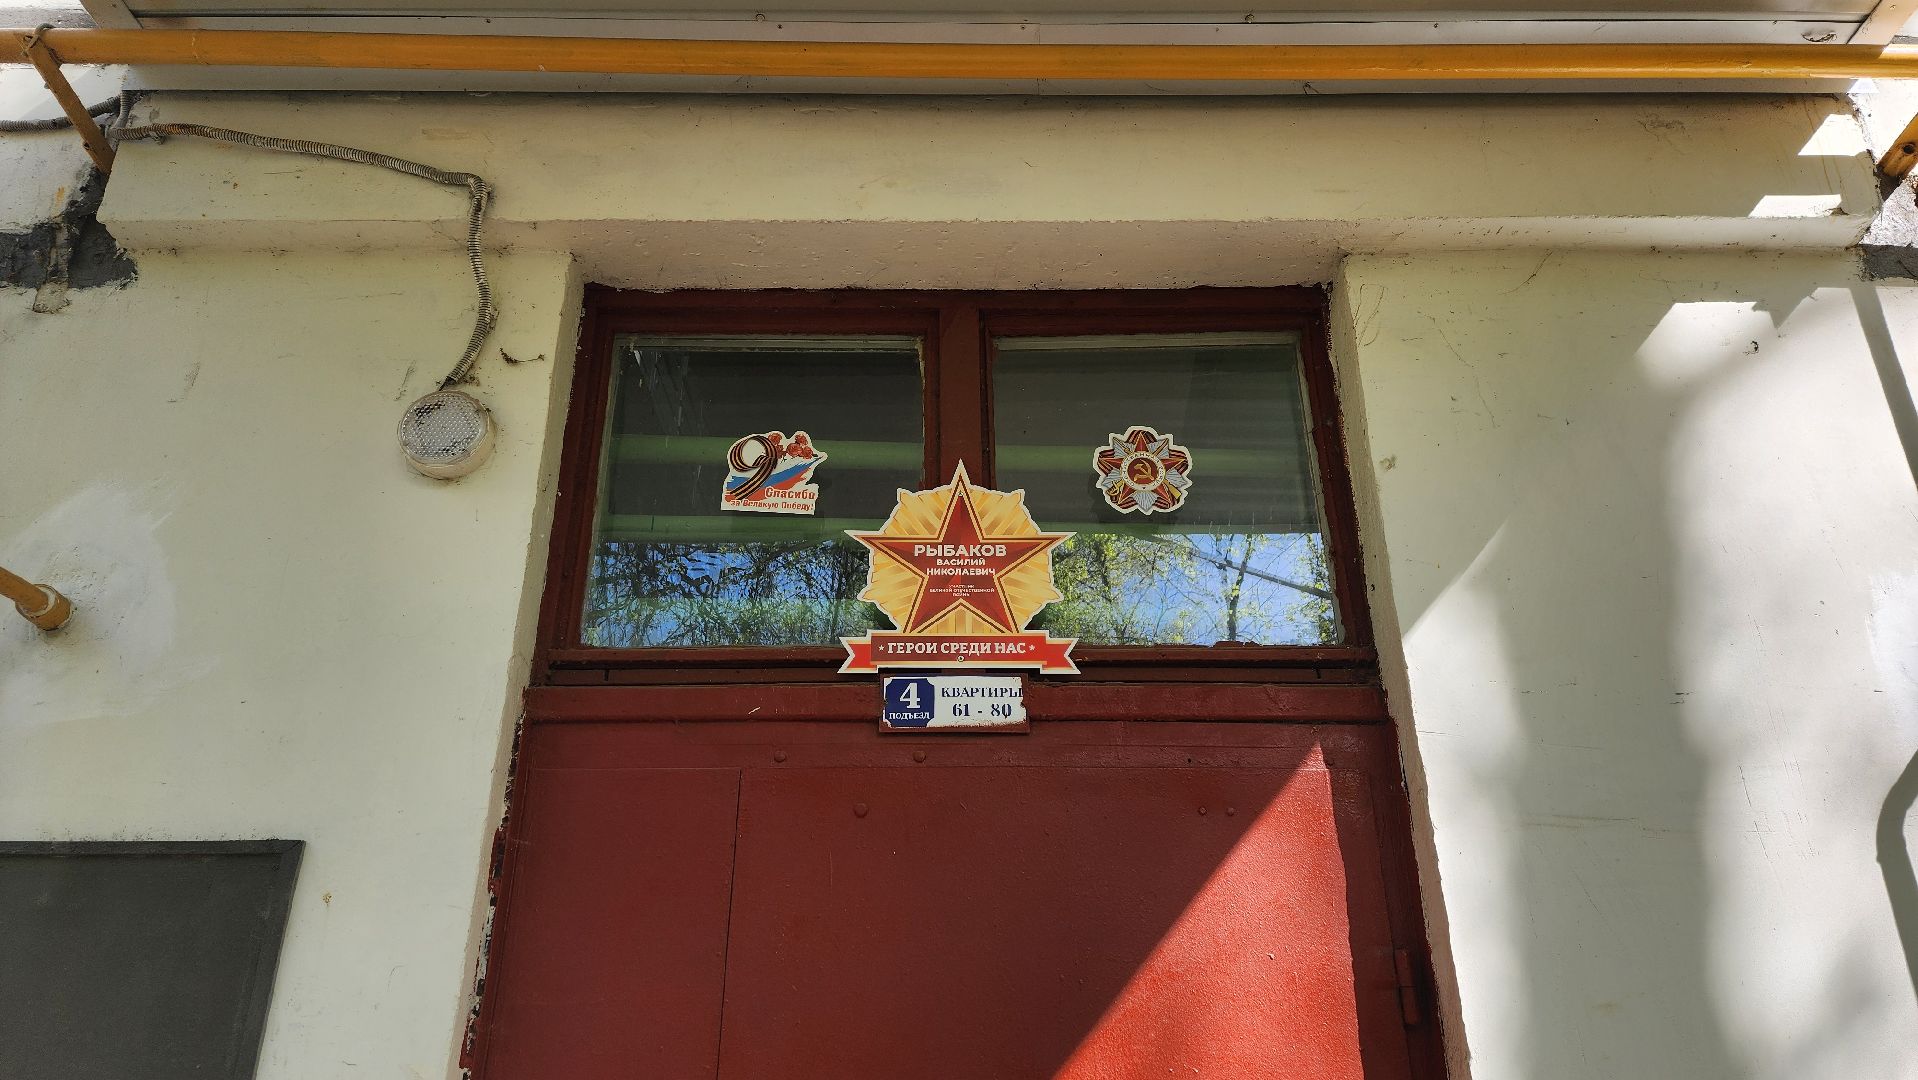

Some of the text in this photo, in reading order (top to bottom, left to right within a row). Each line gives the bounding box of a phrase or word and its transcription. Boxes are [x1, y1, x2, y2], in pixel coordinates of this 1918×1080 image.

[765, 487, 815, 500] Спасибо
[743, 500, 778, 509] Великую
[781, 502, 814, 512] Победу!
[914, 545, 1007, 557] РЫБАКОВ
[936, 558, 986, 566] ВАСИЛИЙ
[926, 568, 996, 576] НИКОЛАЕВИЧ
[887, 642, 1026, 656] ГЕРОИ СРЕДИ НАС
[900, 682, 921, 709] 4
[941, 687, 1024, 698] КВАРТИРЫ
[889, 711, 931, 720] ПОДЪЕЗД
[952, 703, 970, 717] 61
[990, 703, 1012, 717] 80
